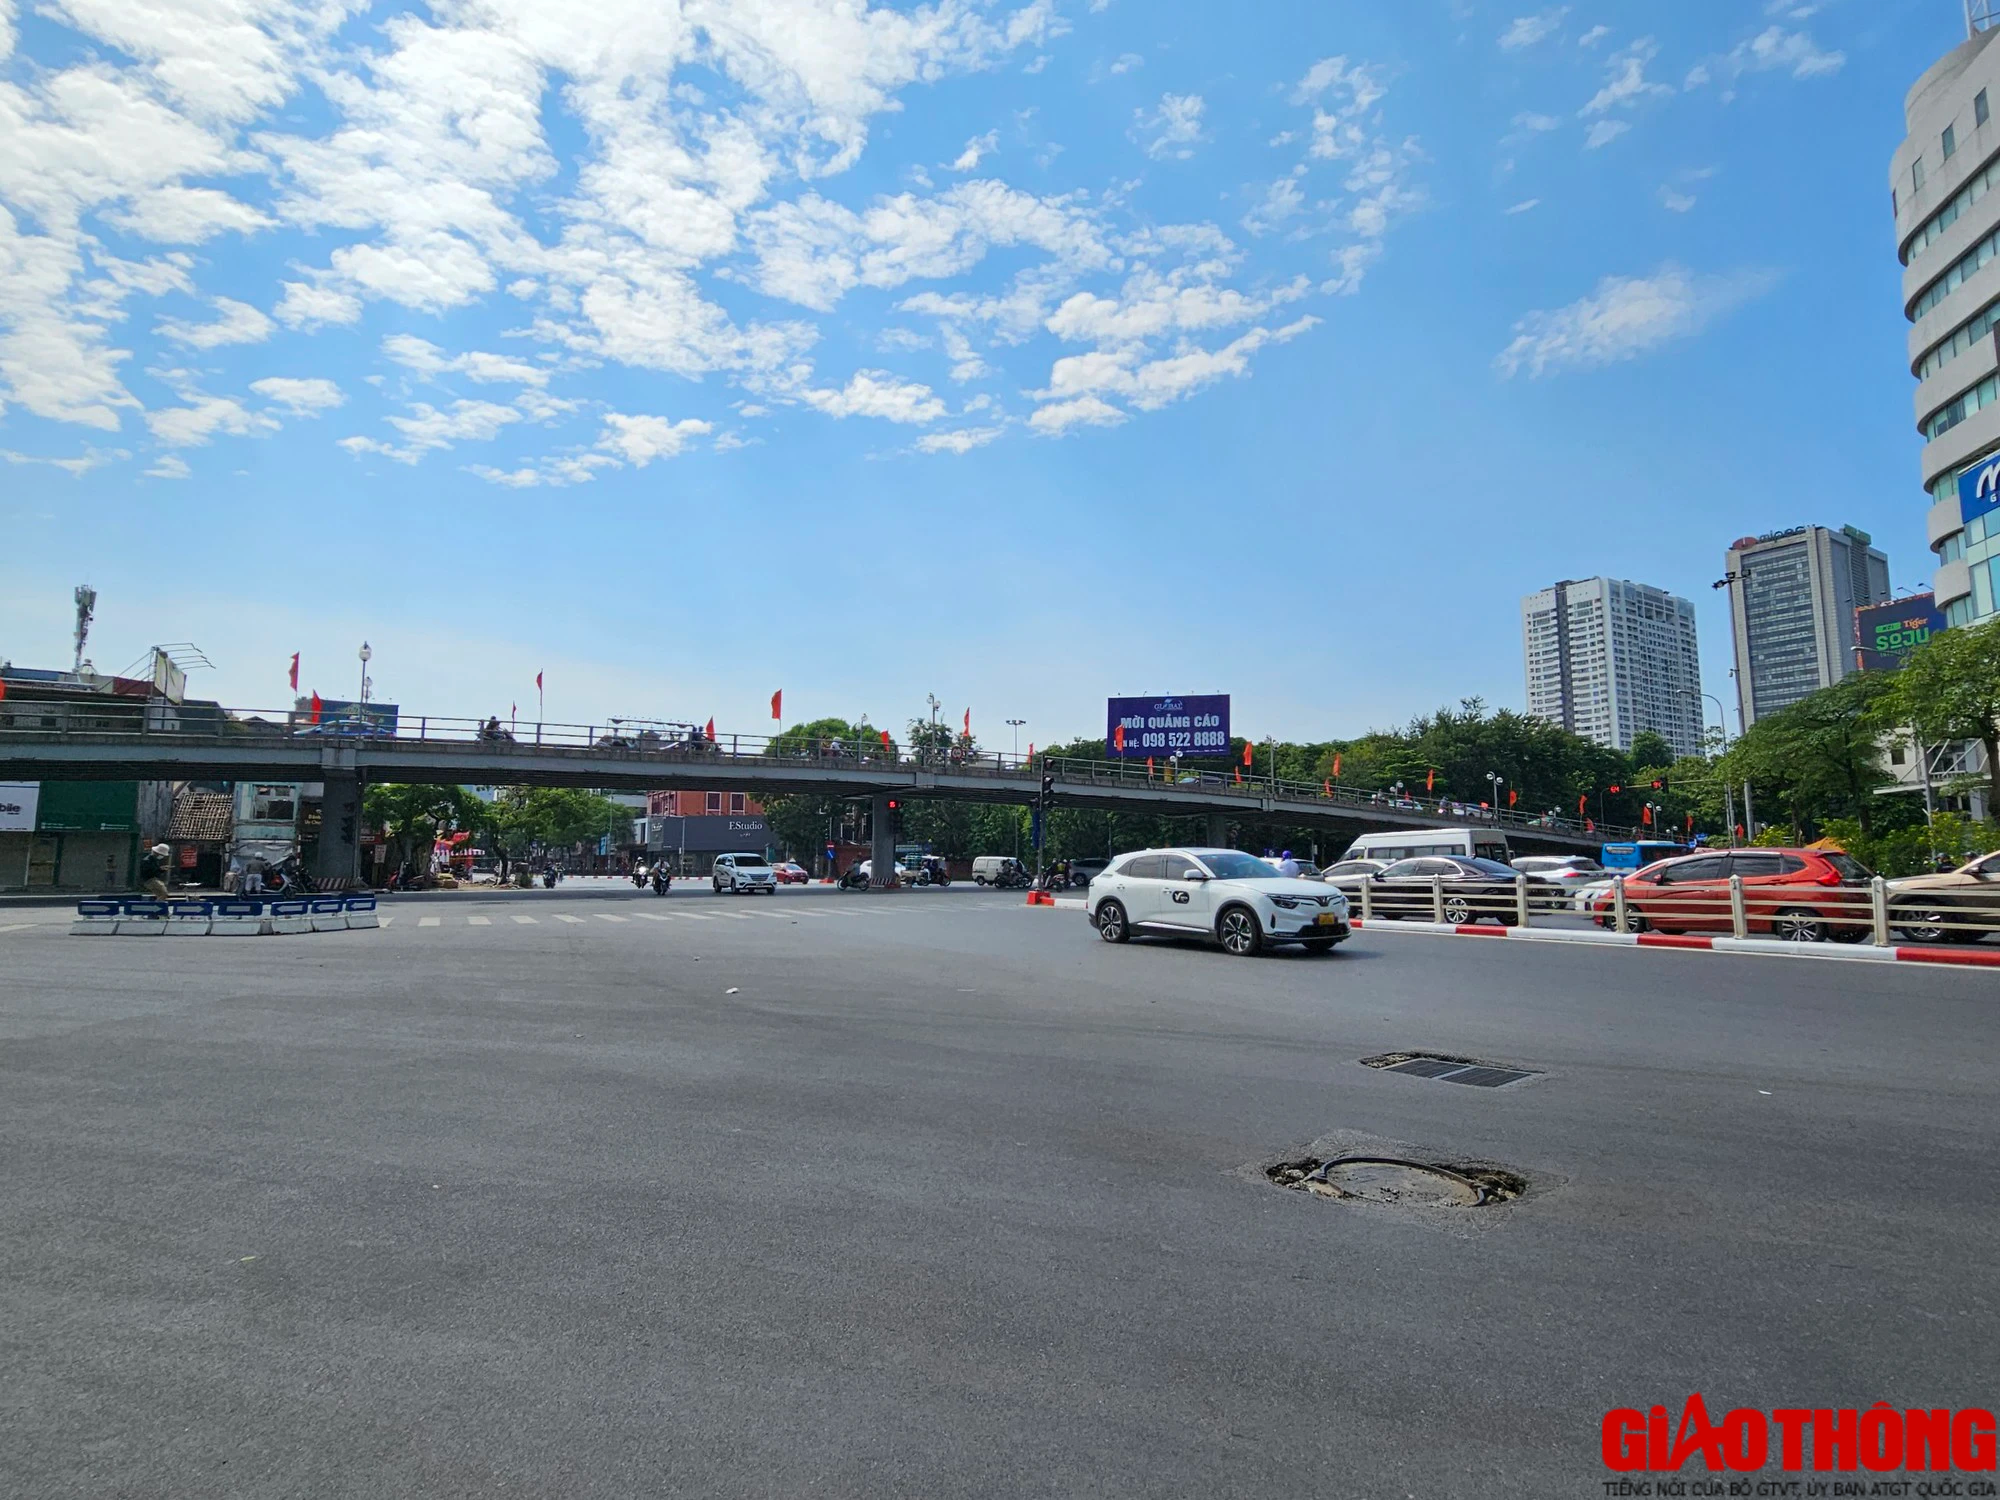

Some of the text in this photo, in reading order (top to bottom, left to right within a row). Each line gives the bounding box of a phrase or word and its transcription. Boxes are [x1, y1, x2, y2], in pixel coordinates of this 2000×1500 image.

[1903, 617, 1928, 629] Tiger
[1120, 713, 1219, 730] MỜI QUẢNG CÁO
[1142, 732, 1166, 748] 098
[1168, 732, 1191, 747] 522
[1193, 730, 1225, 746] 8888
